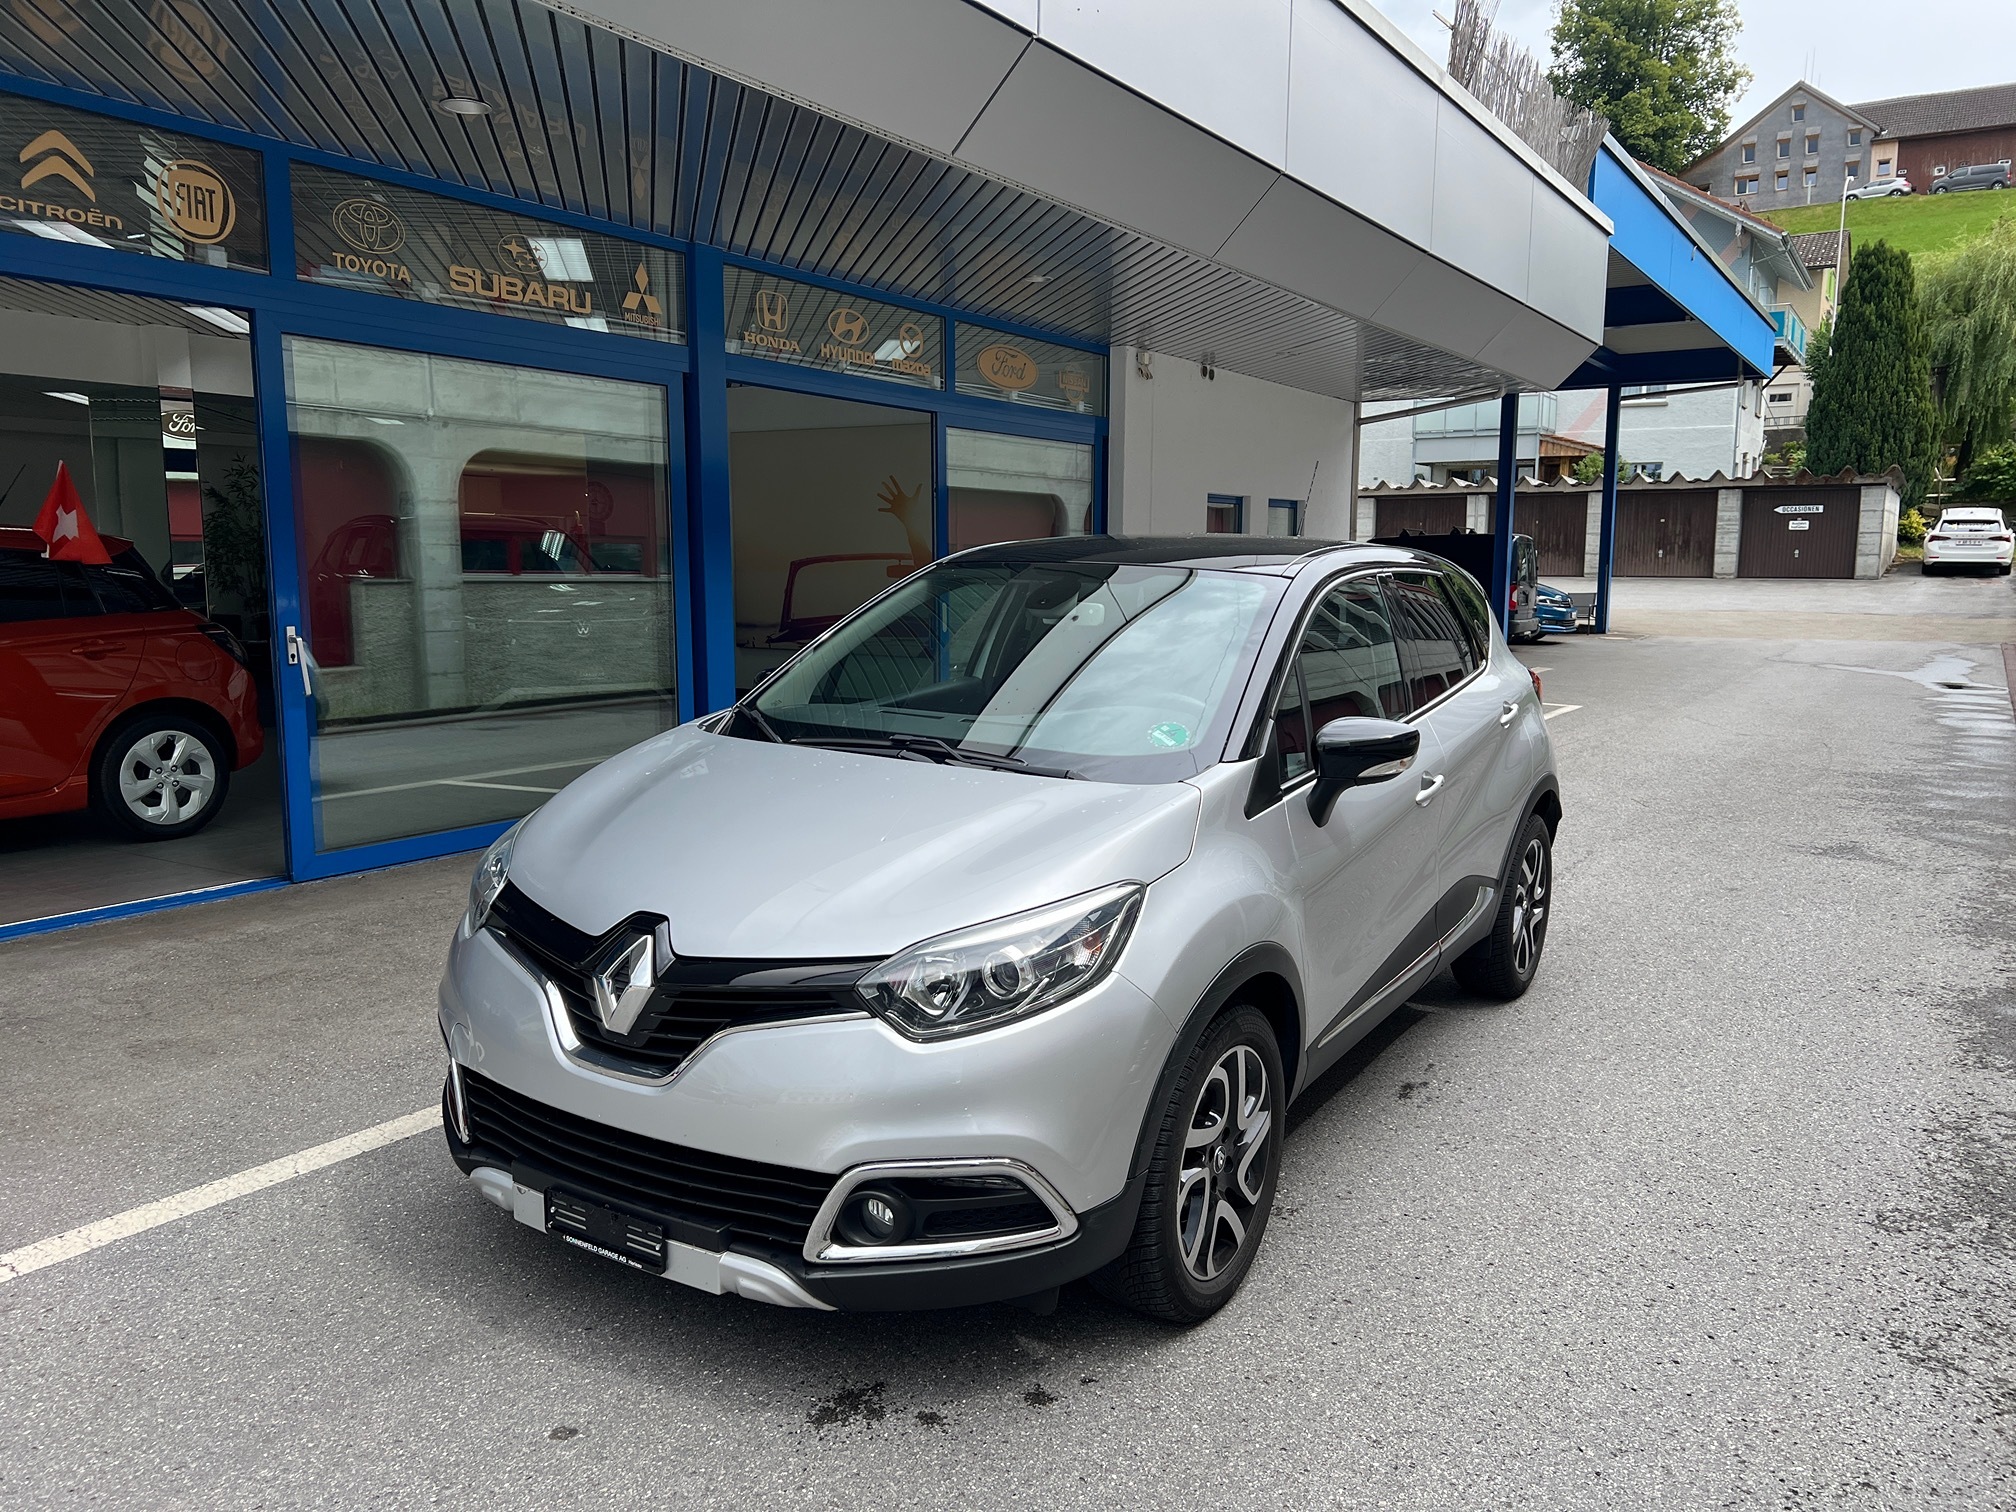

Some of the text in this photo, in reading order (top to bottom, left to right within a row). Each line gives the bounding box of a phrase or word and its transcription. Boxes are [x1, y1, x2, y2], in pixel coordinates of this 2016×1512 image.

[175, 181, 216, 223] FIAT
[332, 252, 412, 283] TOYOTA
[449, 265, 592, 314] SUBARU
[624, 312, 662, 327] MITSUBISHI
[744, 331, 802, 353] HONDA
[820, 343, 876, 366] HYUNDAI
[992, 350, 1027, 380] Ford
[566, 1235, 597, 1252] SONNENFELD
[598, 1247, 619, 1260] GARAGE
[619, 1255, 627, 1263] AG
